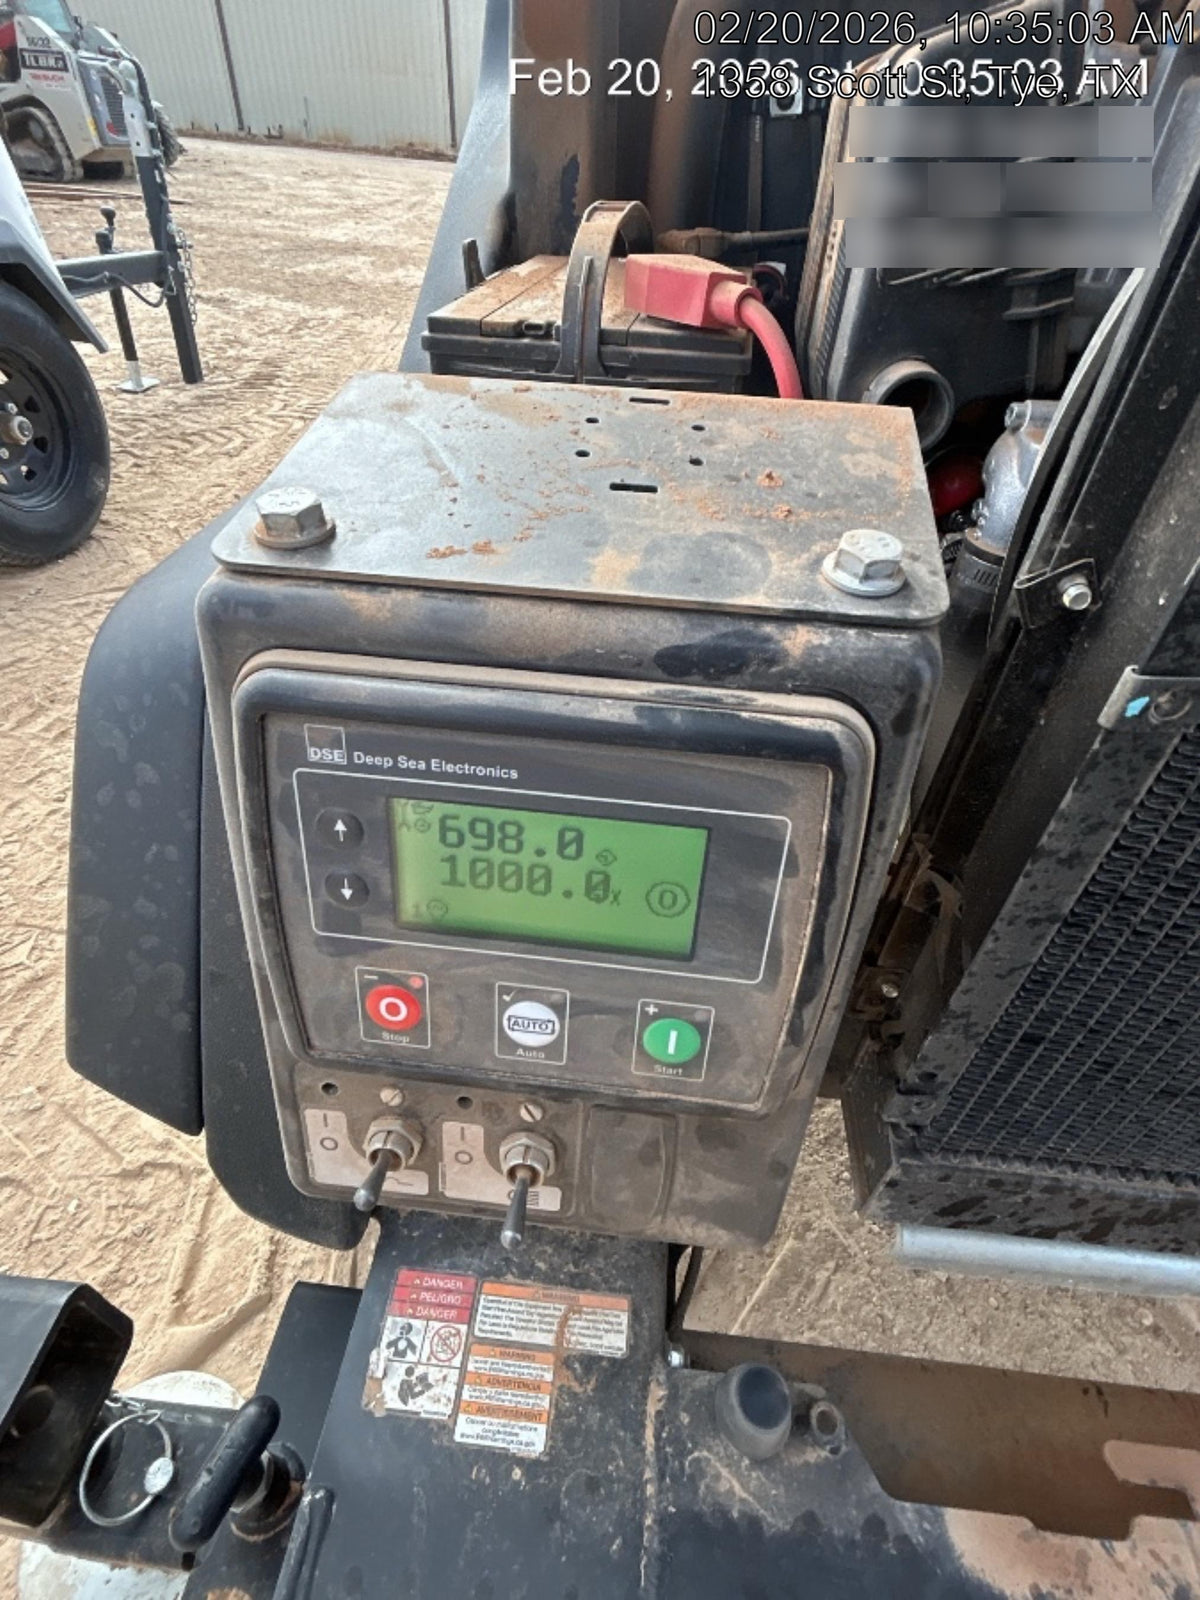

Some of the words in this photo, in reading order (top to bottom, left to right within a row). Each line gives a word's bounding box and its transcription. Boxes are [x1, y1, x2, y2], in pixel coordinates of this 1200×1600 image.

[309, 746, 346, 762] DSE
[353, 751, 394, 769] Deep
[397, 755, 427, 771] Sea
[430, 758, 519, 780] Electronics
[437, 813, 585, 862] 698.0
[439, 853, 612, 905] 1000.0
[511, 1018, 551, 1033] AUTO
[381, 1031, 411, 1045] Stop
[515, 1047, 546, 1060] Auto
[653, 1064, 683, 1077] Start
